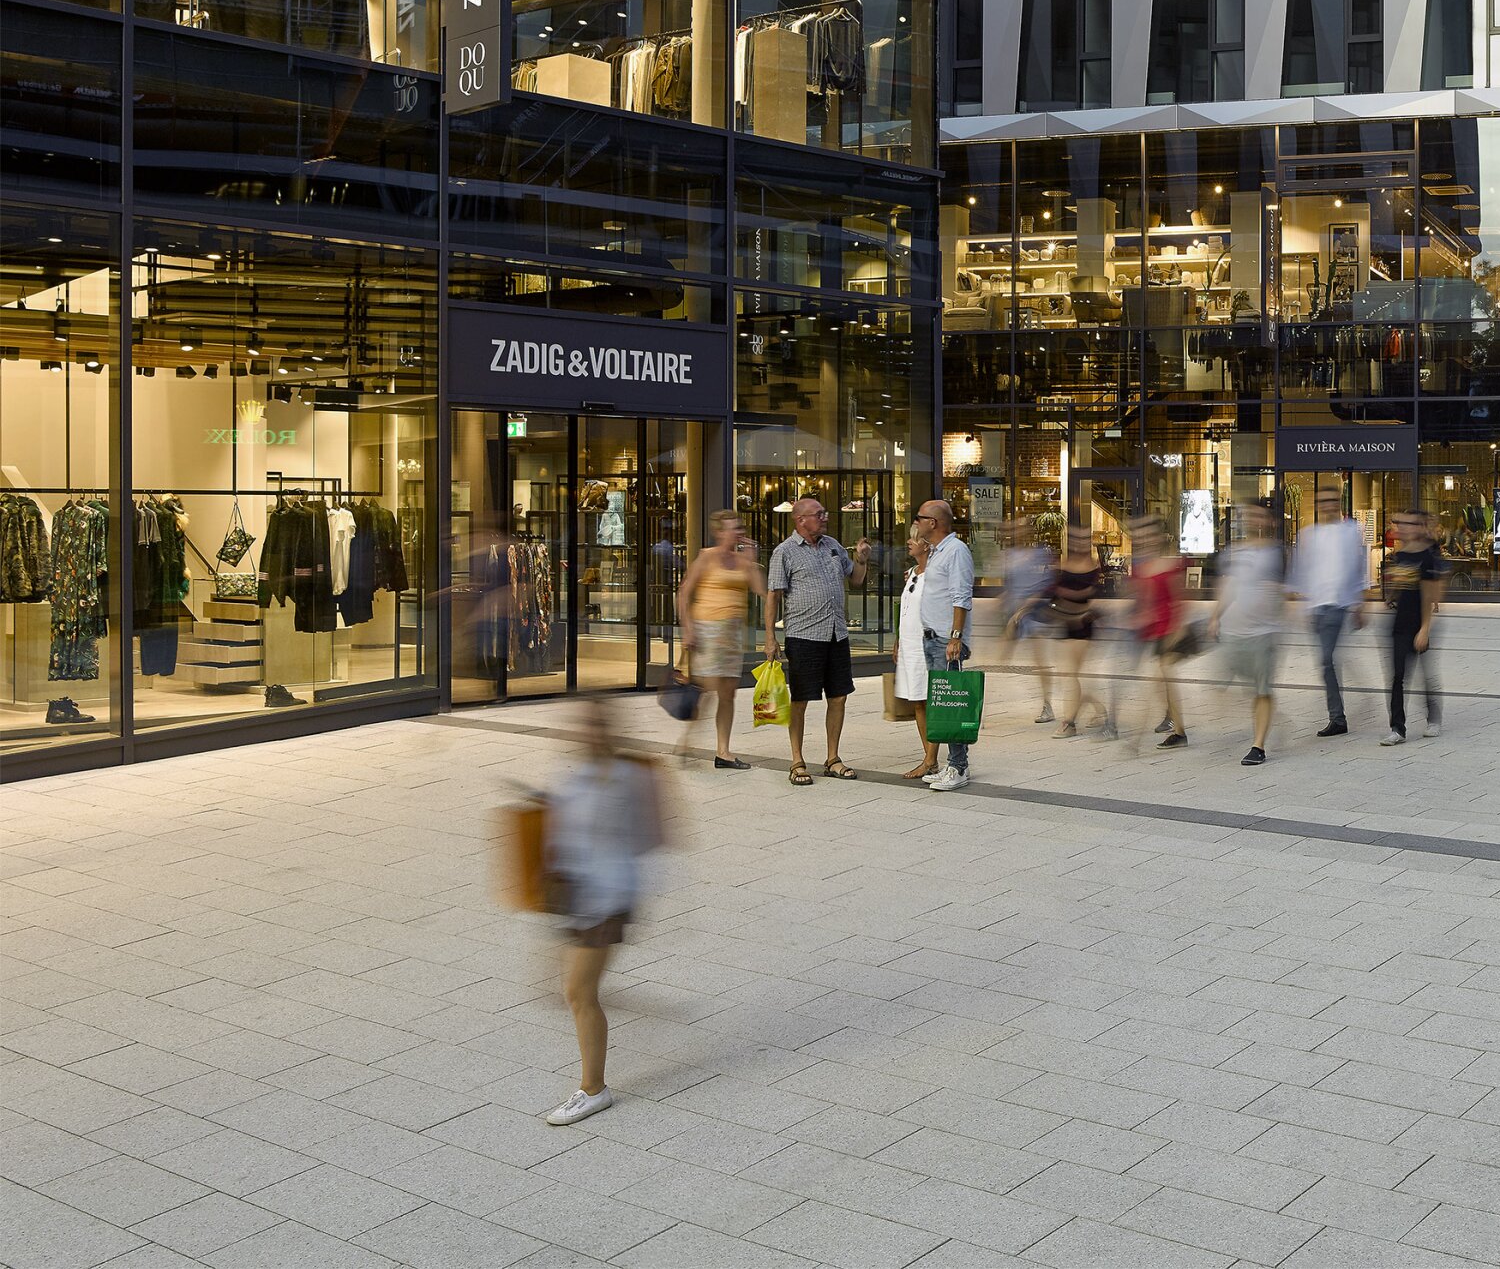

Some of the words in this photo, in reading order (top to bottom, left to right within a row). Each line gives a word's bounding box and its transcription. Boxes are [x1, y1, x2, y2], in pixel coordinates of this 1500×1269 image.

[460, 42, 486, 71] DO
[459, 66, 485, 96] QU
[1296, 440, 1346, 452] RIVIÈRA
[1348, 442, 1396, 452] MAISON
[974, 488, 1000, 499] SALE
